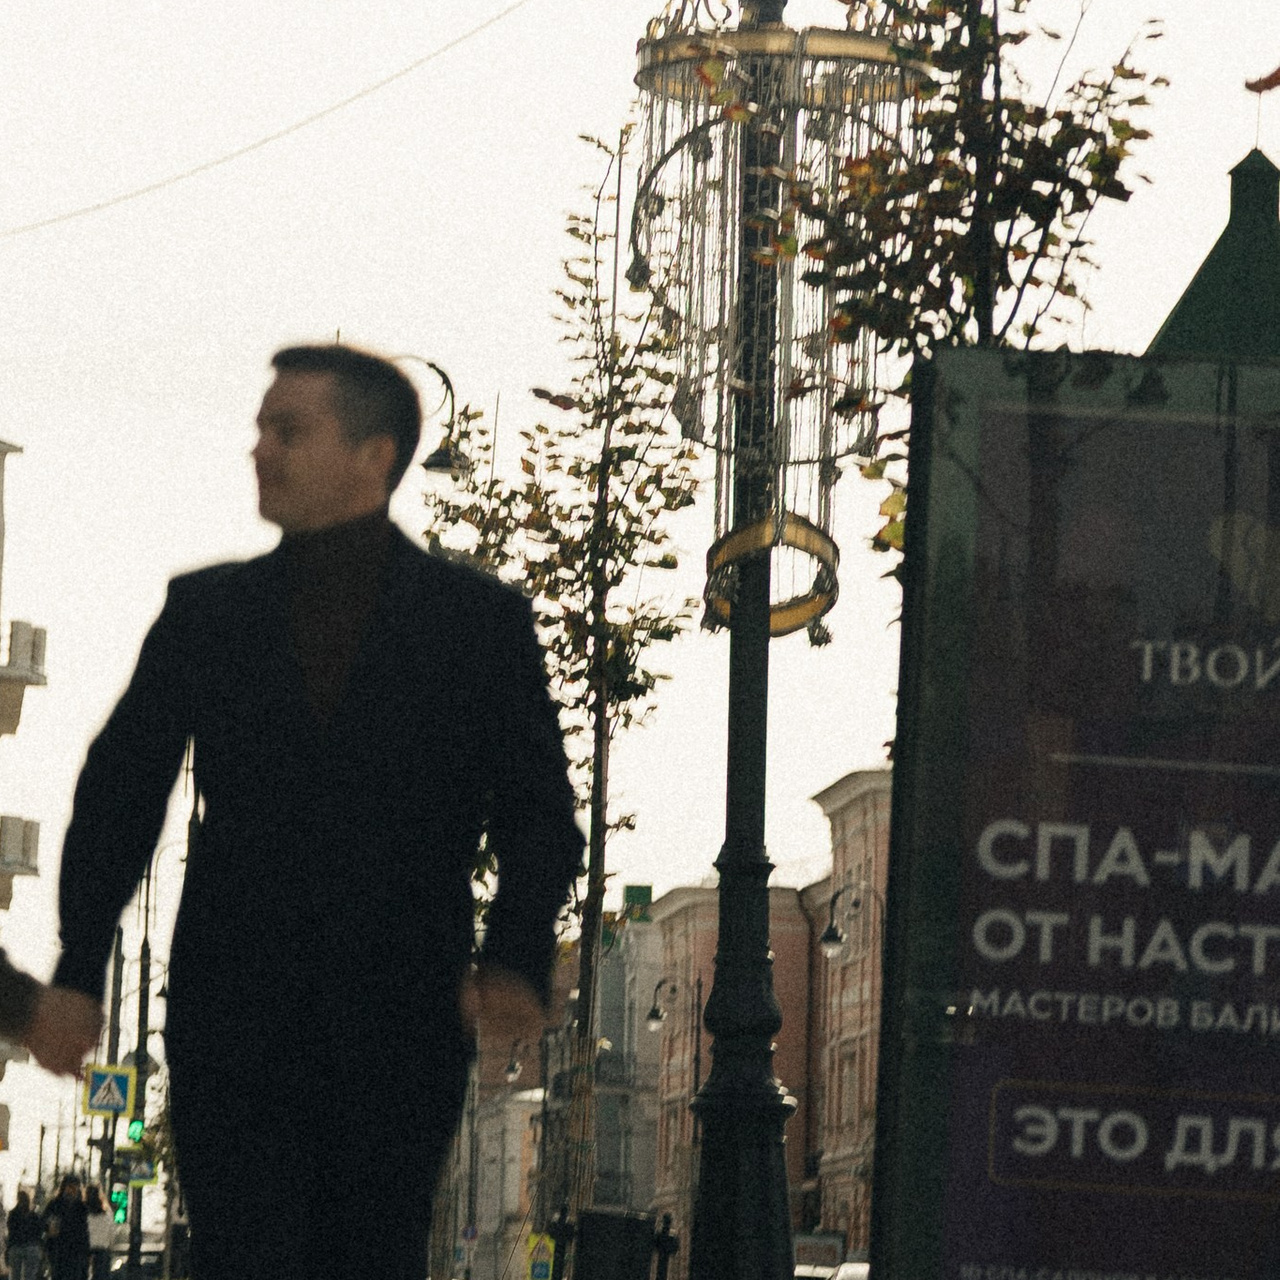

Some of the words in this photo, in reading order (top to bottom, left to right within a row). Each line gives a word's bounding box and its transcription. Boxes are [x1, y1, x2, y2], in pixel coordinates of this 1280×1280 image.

[971, 907, 1070, 964] ОТ
[1087, 914, 1280, 977] НАСТ
[969, 987, 1181, 1028] МАСТЕРОВ
[1011, 1103, 1150, 1162] ЭТО
